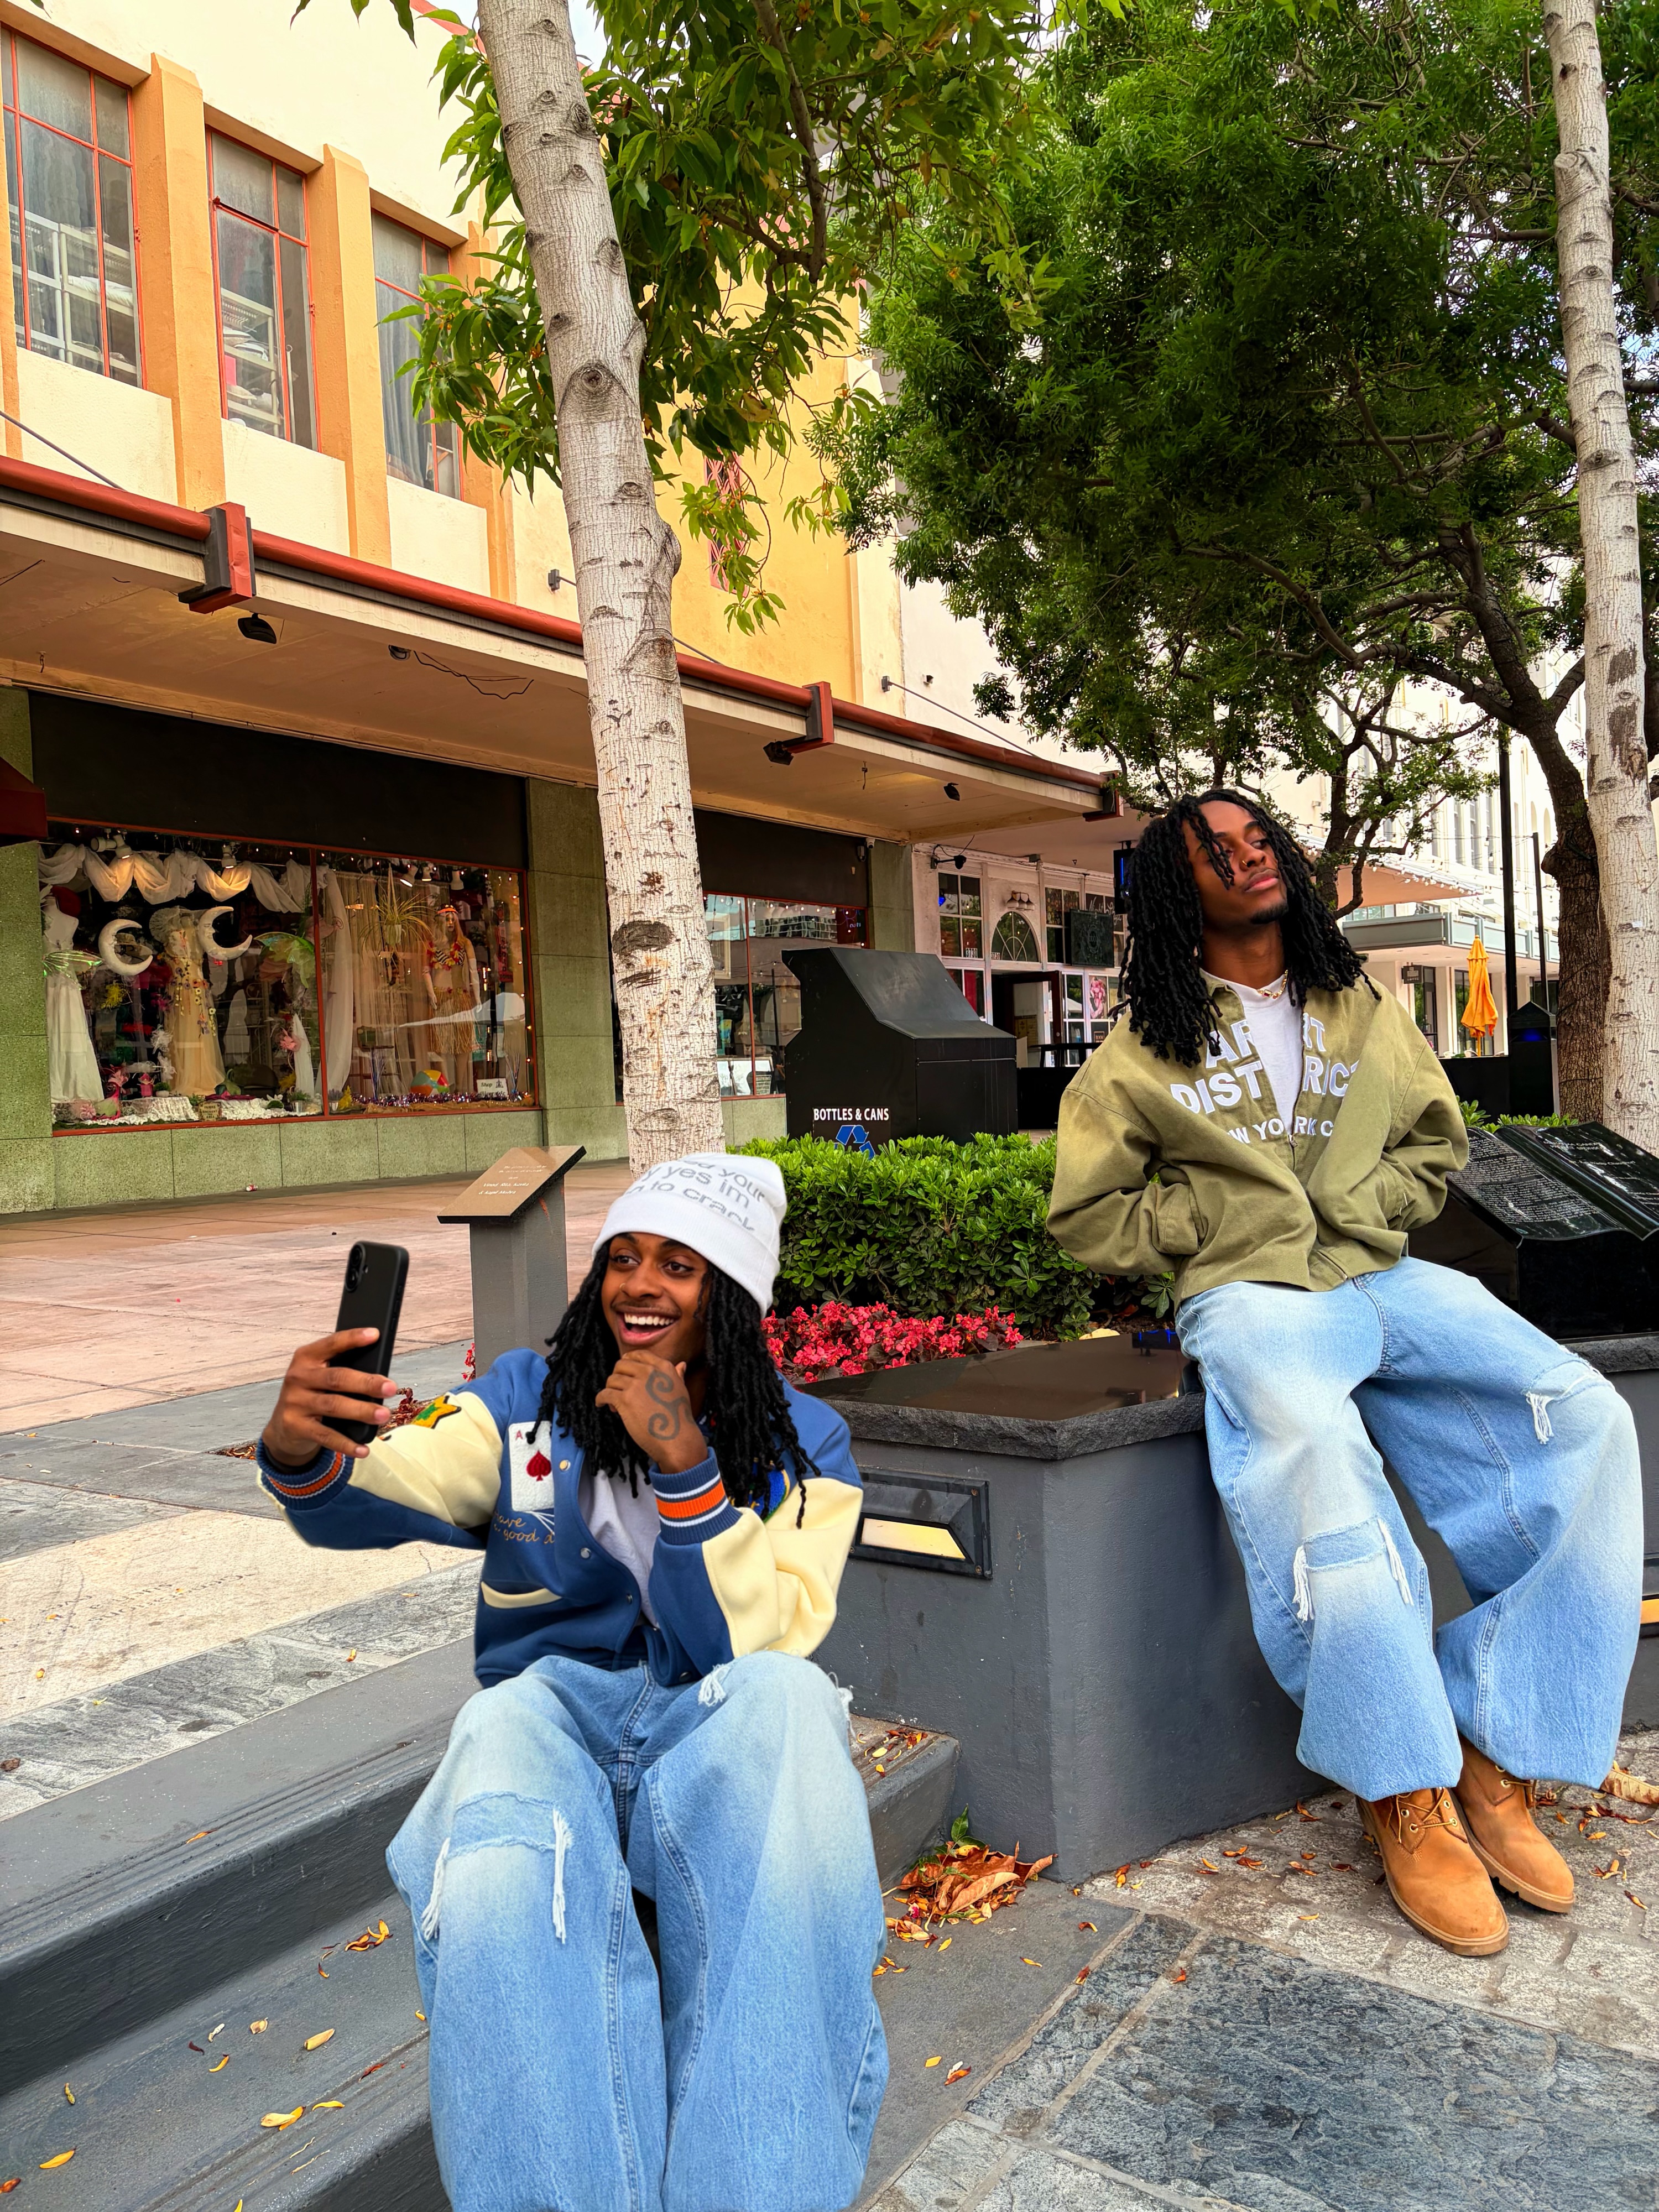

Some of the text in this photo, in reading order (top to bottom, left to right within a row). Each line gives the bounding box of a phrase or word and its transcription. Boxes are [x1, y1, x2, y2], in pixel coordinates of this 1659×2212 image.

[813, 1108, 889, 1121] BOTTLES & CANS
[1252, 1116, 1318, 1140] YORK
[662, 1166, 712, 1186] yes
[719, 1179, 750, 1209] im
[718, 1168, 766, 1202] your
[515, 1430, 523, 1441] A
[495, 1512, 526, 1528] ave
[503, 1528, 540, 1542] good
